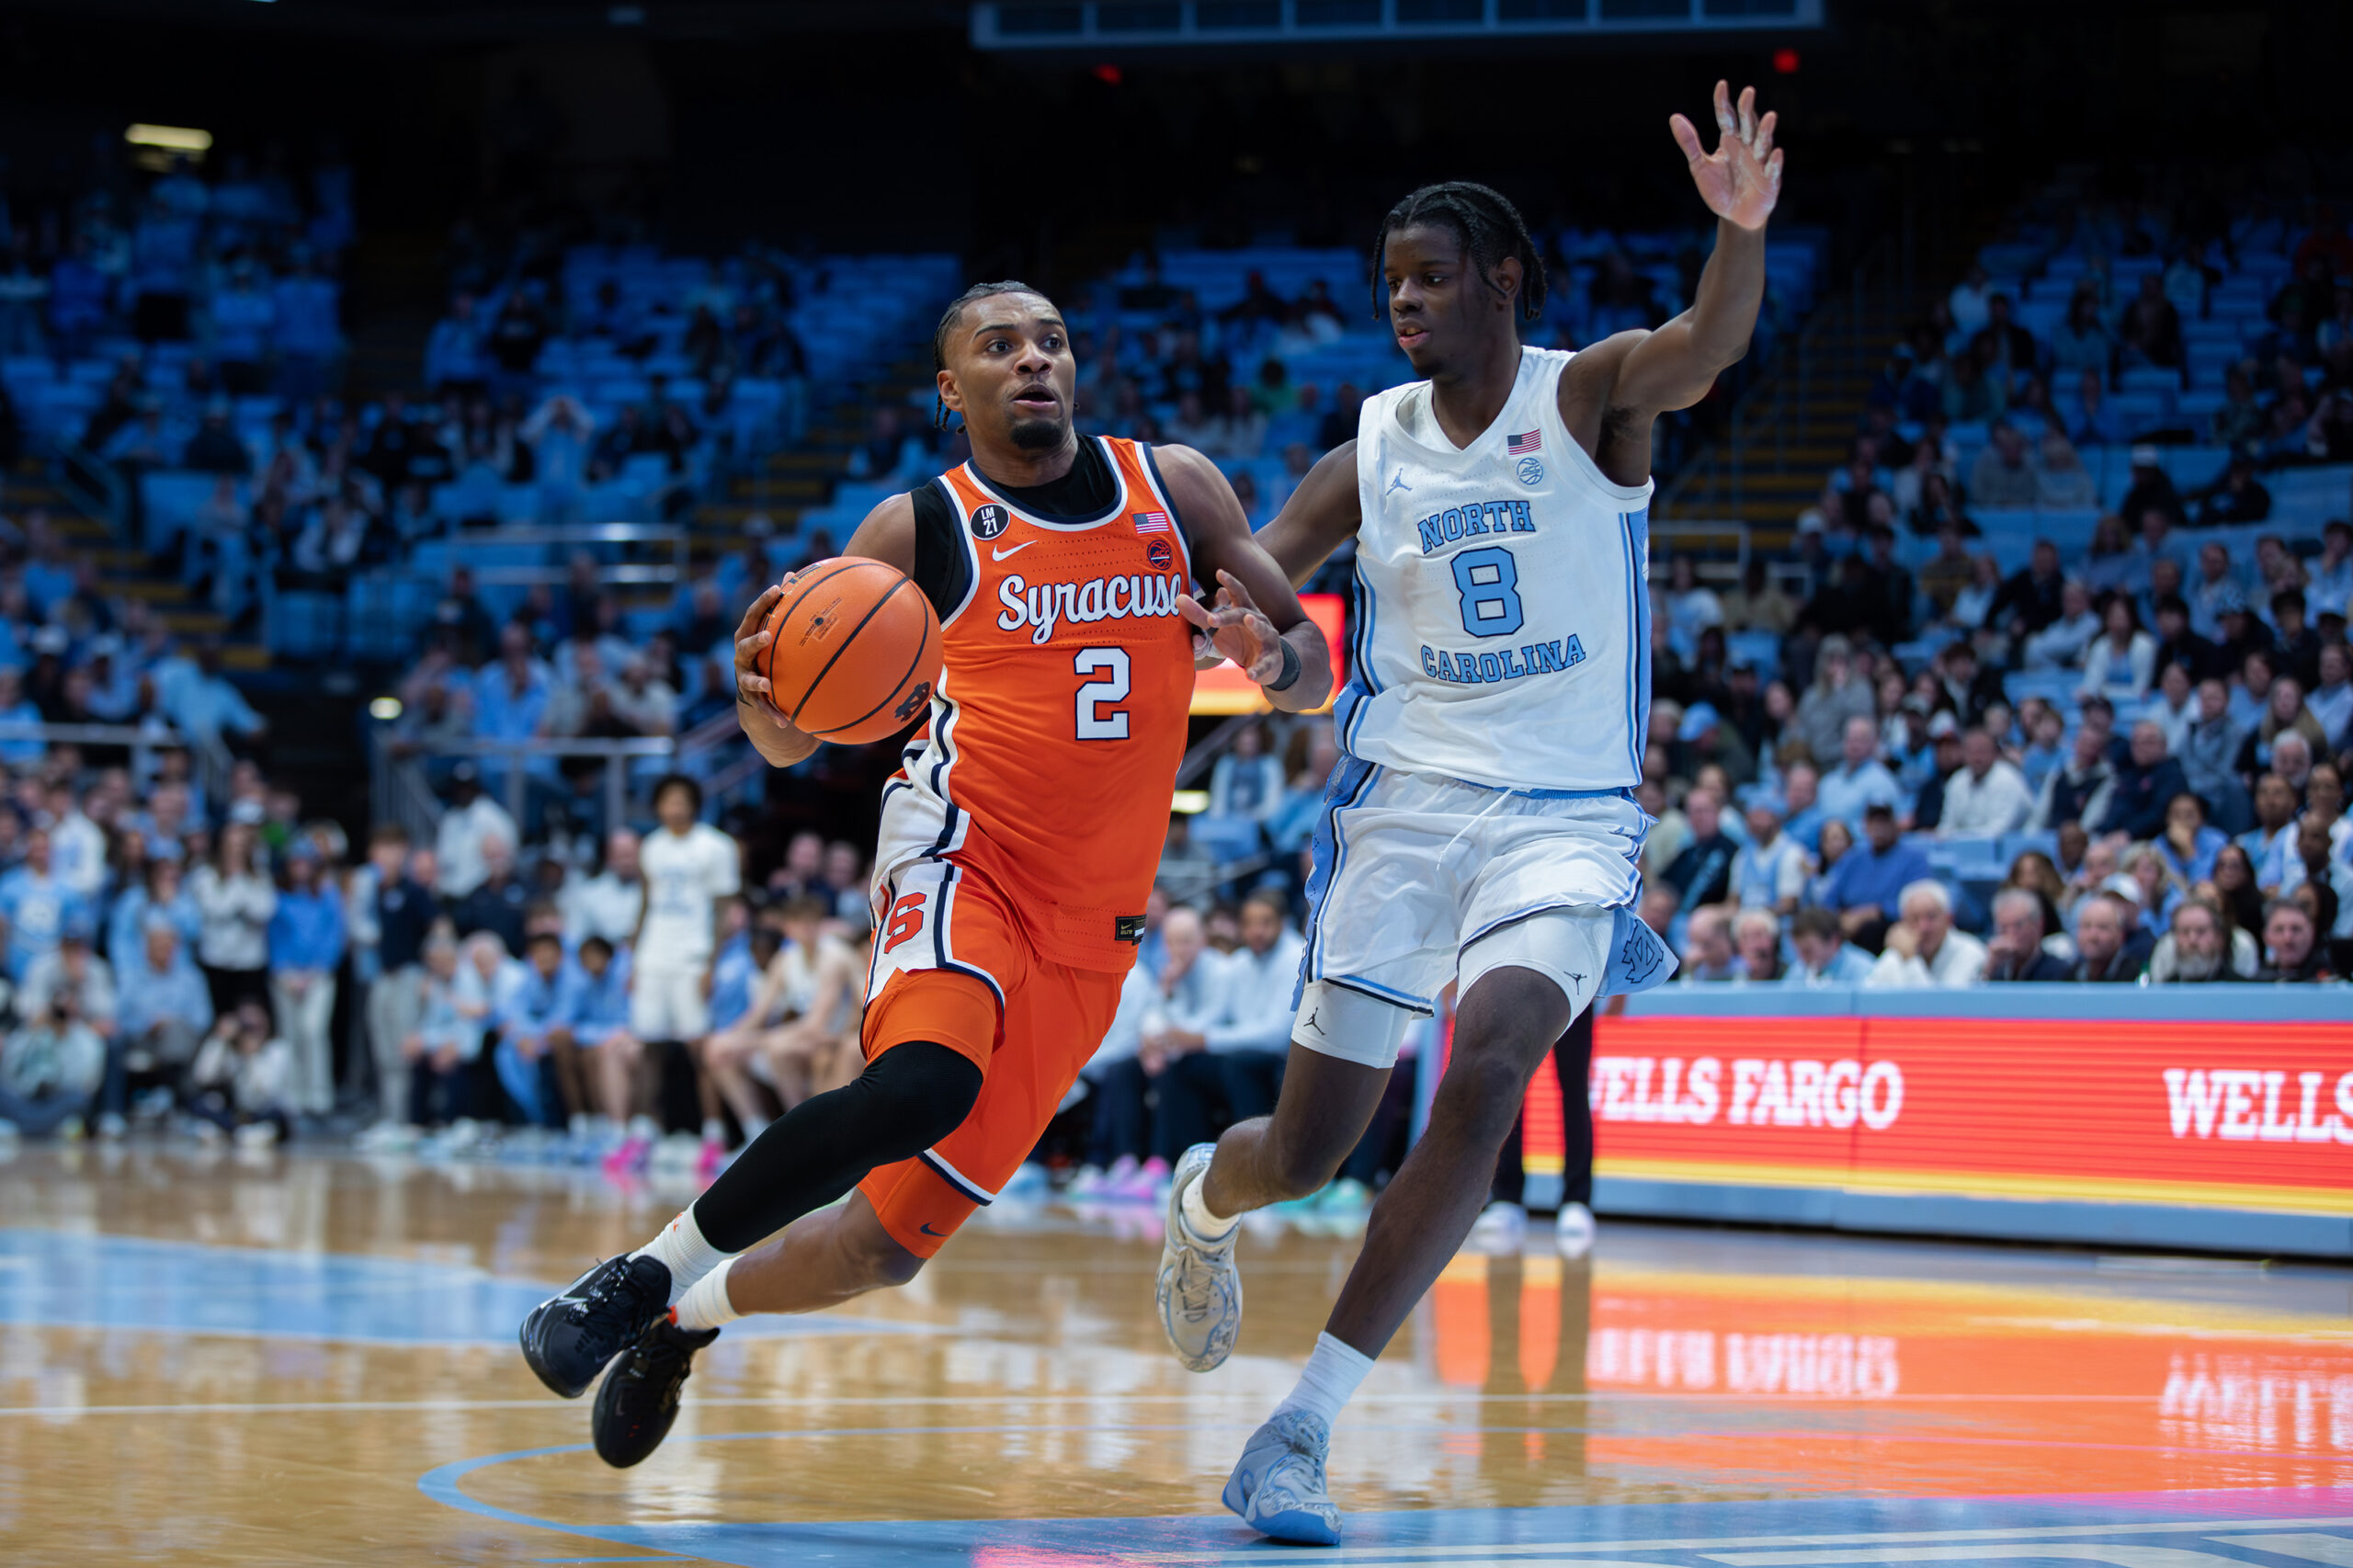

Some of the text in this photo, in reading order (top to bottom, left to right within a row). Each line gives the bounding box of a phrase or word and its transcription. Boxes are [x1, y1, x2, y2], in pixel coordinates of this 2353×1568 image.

[981, 506, 995, 520] LM
[983, 517, 998, 536] 21
[1417, 500, 1536, 554] NORTH
[997, 573, 1182, 645] Syracuse
[1450, 546, 1525, 638] 8
[1420, 633, 1586, 684] CAROLINA
[1074, 646, 1131, 741] 2
[883, 892, 927, 954] S
[1727, 1058, 1904, 1130] FARGO
